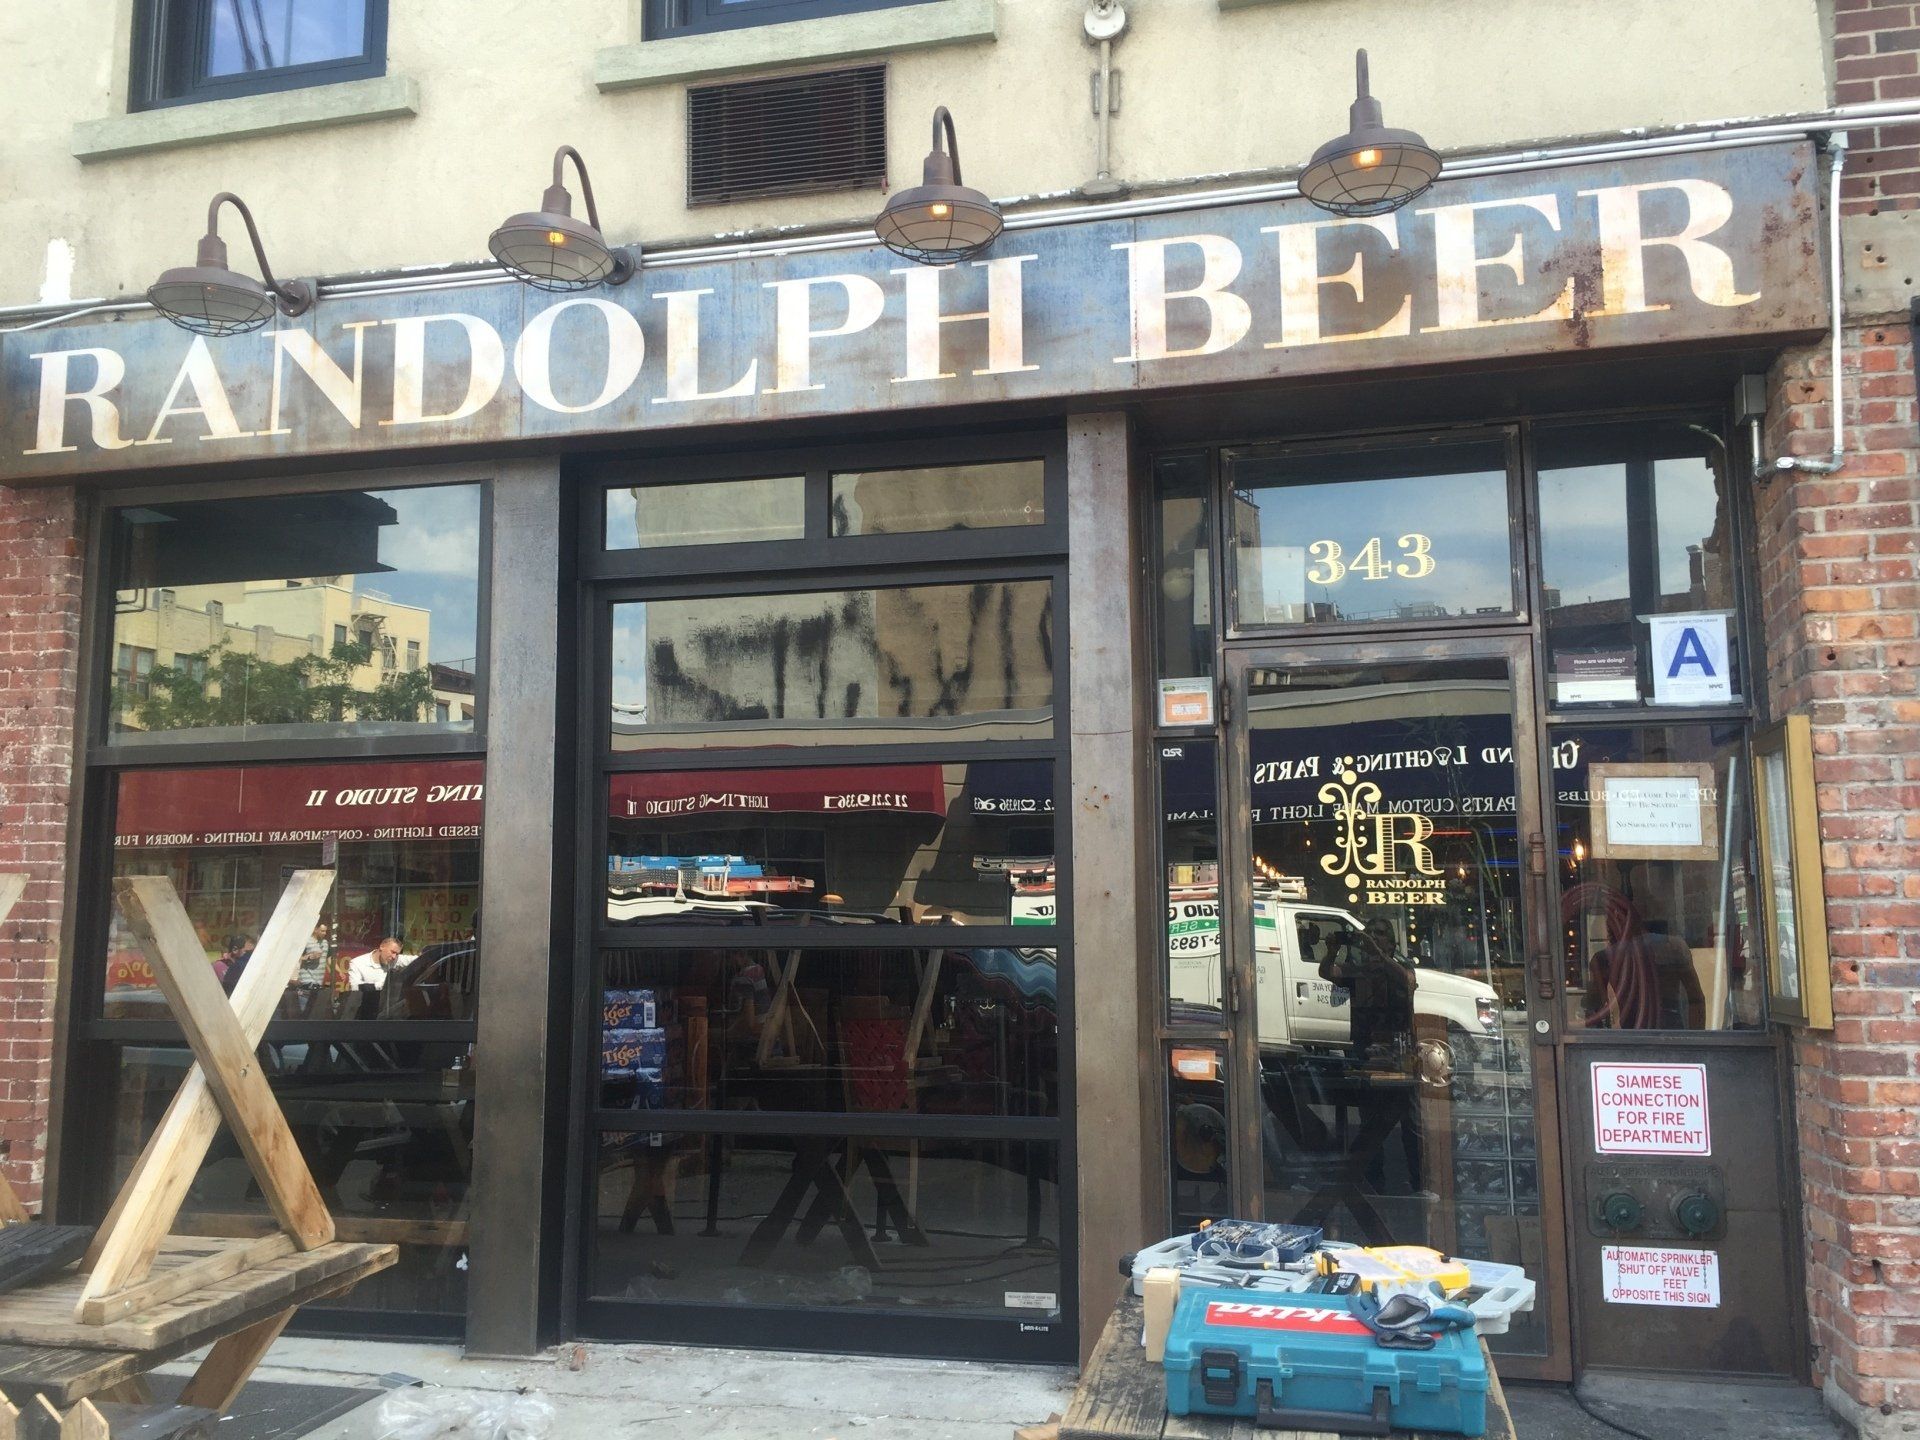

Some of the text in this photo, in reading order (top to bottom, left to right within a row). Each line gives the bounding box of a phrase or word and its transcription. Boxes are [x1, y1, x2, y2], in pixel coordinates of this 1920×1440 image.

[22, 177, 1761, 456] RANDOLPH BEER
[1308, 532, 1436, 585] 343
[1666, 627, 1717, 678] A
[1607, 657, 1626, 666] doing?
[1366, 879, 1446, 889] RANDOLPH
[1366, 891, 1447, 905] BEER
[602, 1045, 643, 1067] Tiger
[1616, 1074, 1682, 1089] SIAMESE
[1601, 1092, 1699, 1107] CONNECTION
[1617, 1111, 1685, 1126] FOR FIRE
[1602, 1128, 1703, 1144] DEPARTMENT
[1606, 1250, 1713, 1265] AUTOMATIC SPRINKLER
[1619, 1263, 1700, 1277] SHUT OFF VALVE
[1663, 1278, 1687, 1290] FEET
[1612, 1288, 1711, 1304] OPPOSITE THIS SIGN
